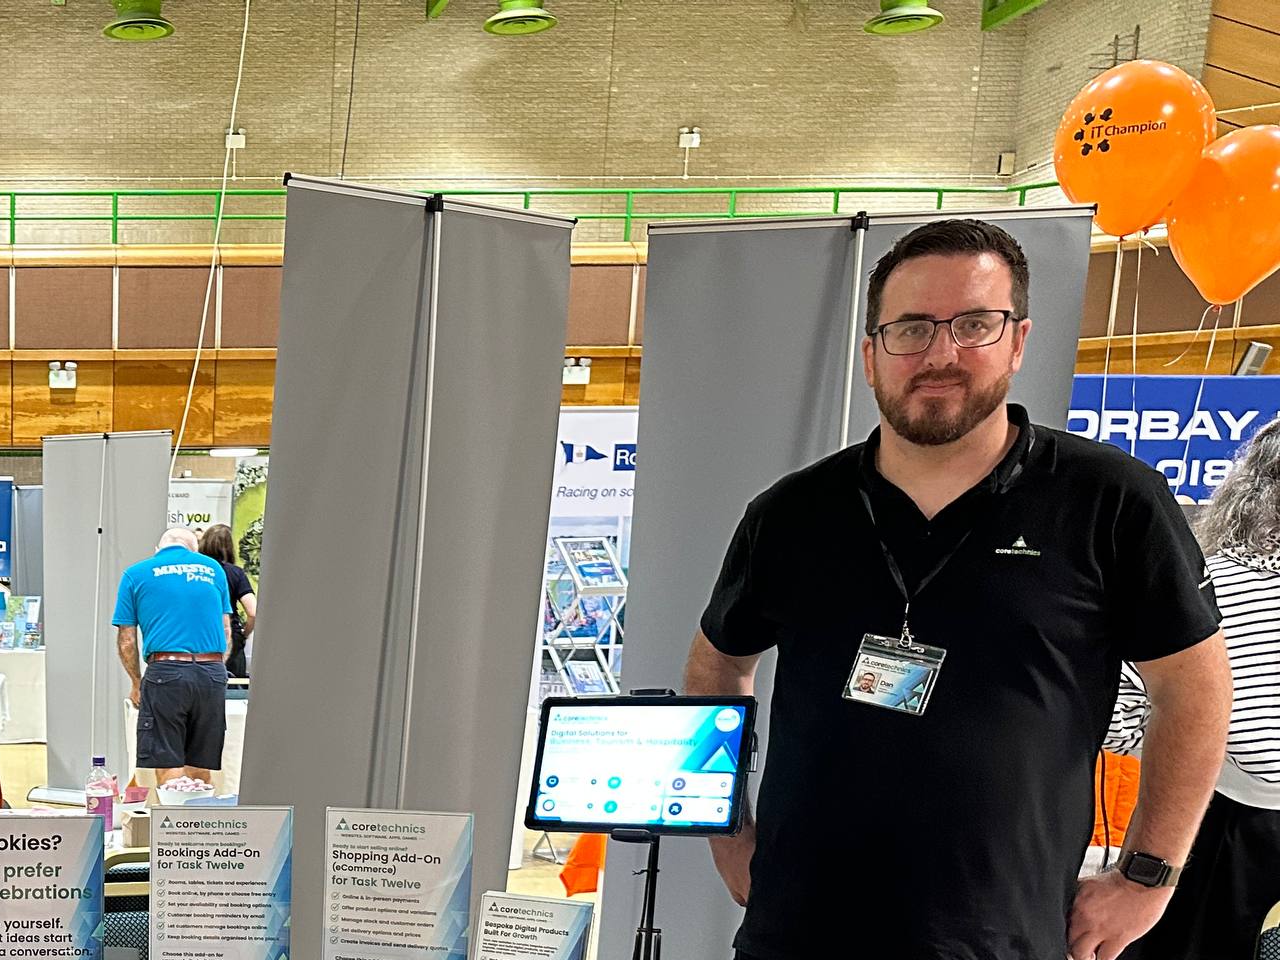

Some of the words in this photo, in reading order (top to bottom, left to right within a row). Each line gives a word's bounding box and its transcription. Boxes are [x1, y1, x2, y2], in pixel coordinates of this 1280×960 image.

[1091, 126, 1103, 139] iT
[1105, 120, 1166, 136] Champion
[1066, 410, 1259, 441] ORBAY
[557, 486, 598, 500] Racing
[601, 488, 616, 496] on
[186, 513, 210, 526] you
[996, 548, 1041, 556] coretechnics
[176, 820, 247, 828] coretechnics
[352, 823, 425, 833] coretechnics
[157, 848, 210, 859] Bookings
[214, 848, 260, 857] Add-On
[332, 850, 389, 864] Shopping
[392, 853, 441, 864] Add-On
[157, 860, 172, 869] for
[177, 861, 202, 869] Task
[206, 861, 245, 869] Twelve
[332, 862, 396, 875] (eCommerce)
[4, 862, 62, 882] prefer
[332, 875, 348, 885] for
[351, 877, 377, 887] Task
[381, 879, 421, 889] Twelve
[500, 907, 553, 918] coretechnics
[4, 918, 64, 932] yourself.
[485, 921, 513, 930] Bespoke
[515, 924, 537, 932] Digital
[539, 927, 569, 936] Products
[7, 933, 40, 943] ideas
[43, 933, 73, 943] start
[512, 932, 538, 940] Growth
[0, 949, 6, 957] a
[9, 947, 93, 957] conversation.
